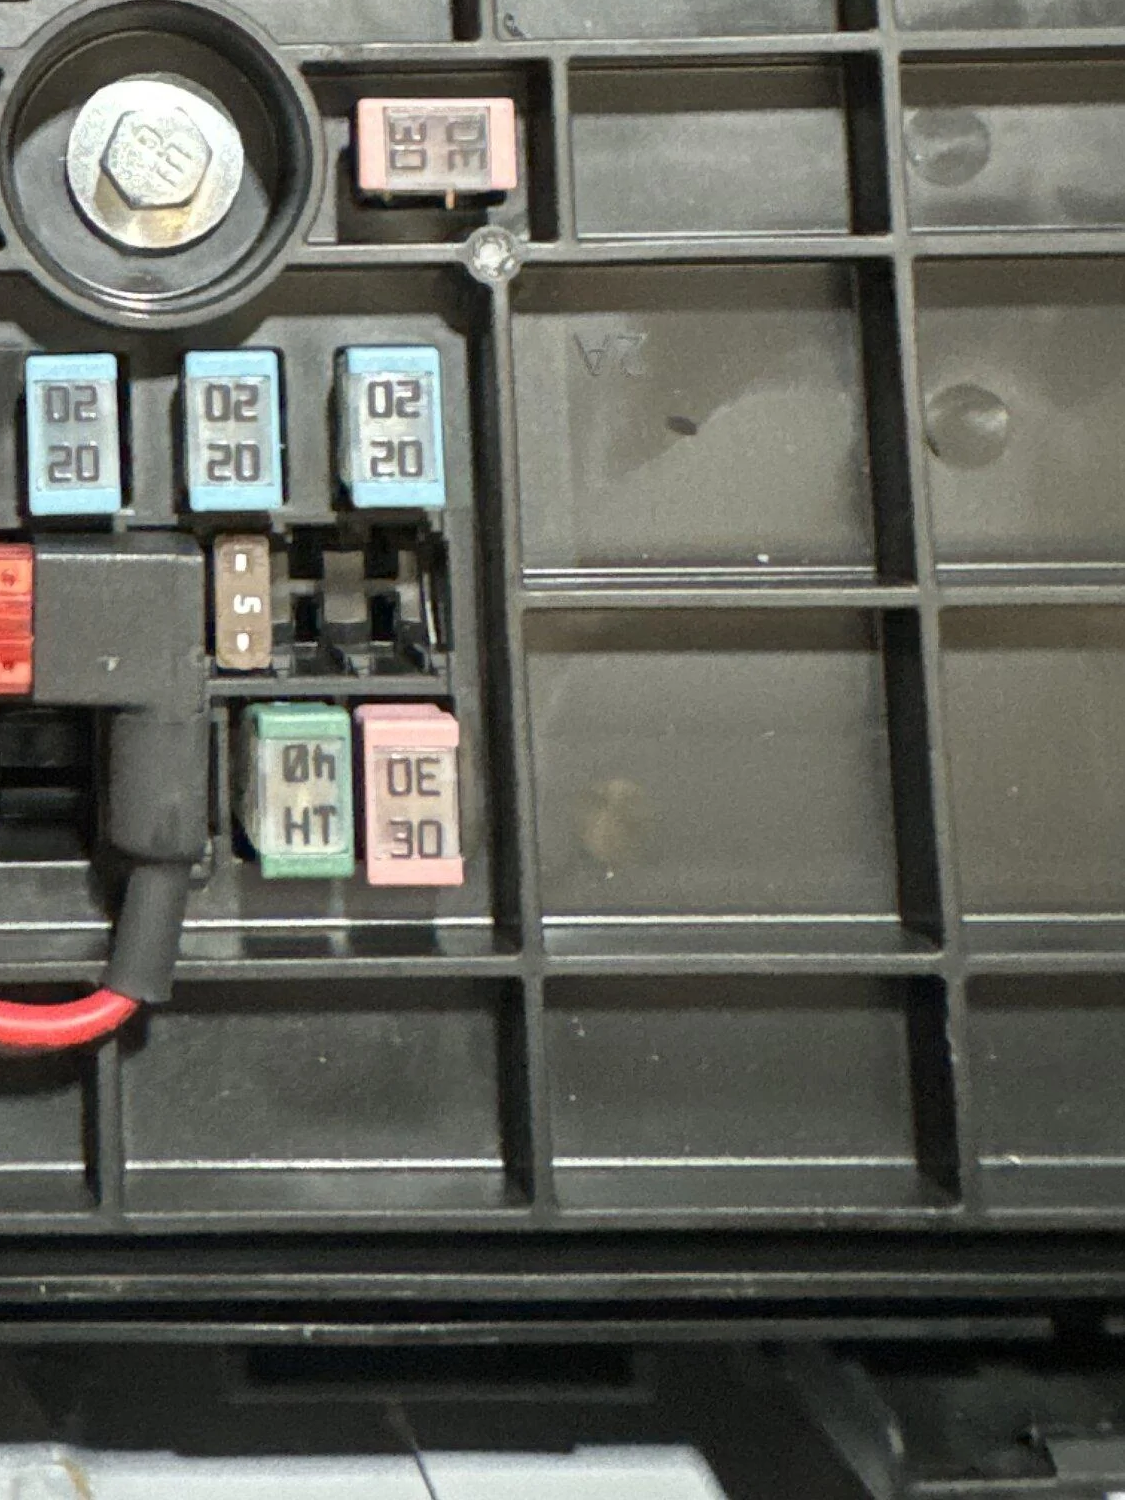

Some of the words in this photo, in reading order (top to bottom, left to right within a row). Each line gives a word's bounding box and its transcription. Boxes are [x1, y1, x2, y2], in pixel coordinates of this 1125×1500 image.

[389, 120, 427, 170] 30
[47, 445, 99, 483] 20
[206, 443, 261, 482] 20
[370, 439, 423, 478] 20
[233, 595, 261, 615] 5
[285, 808, 337, 846] HT
[389, 820, 442, 859] 30
